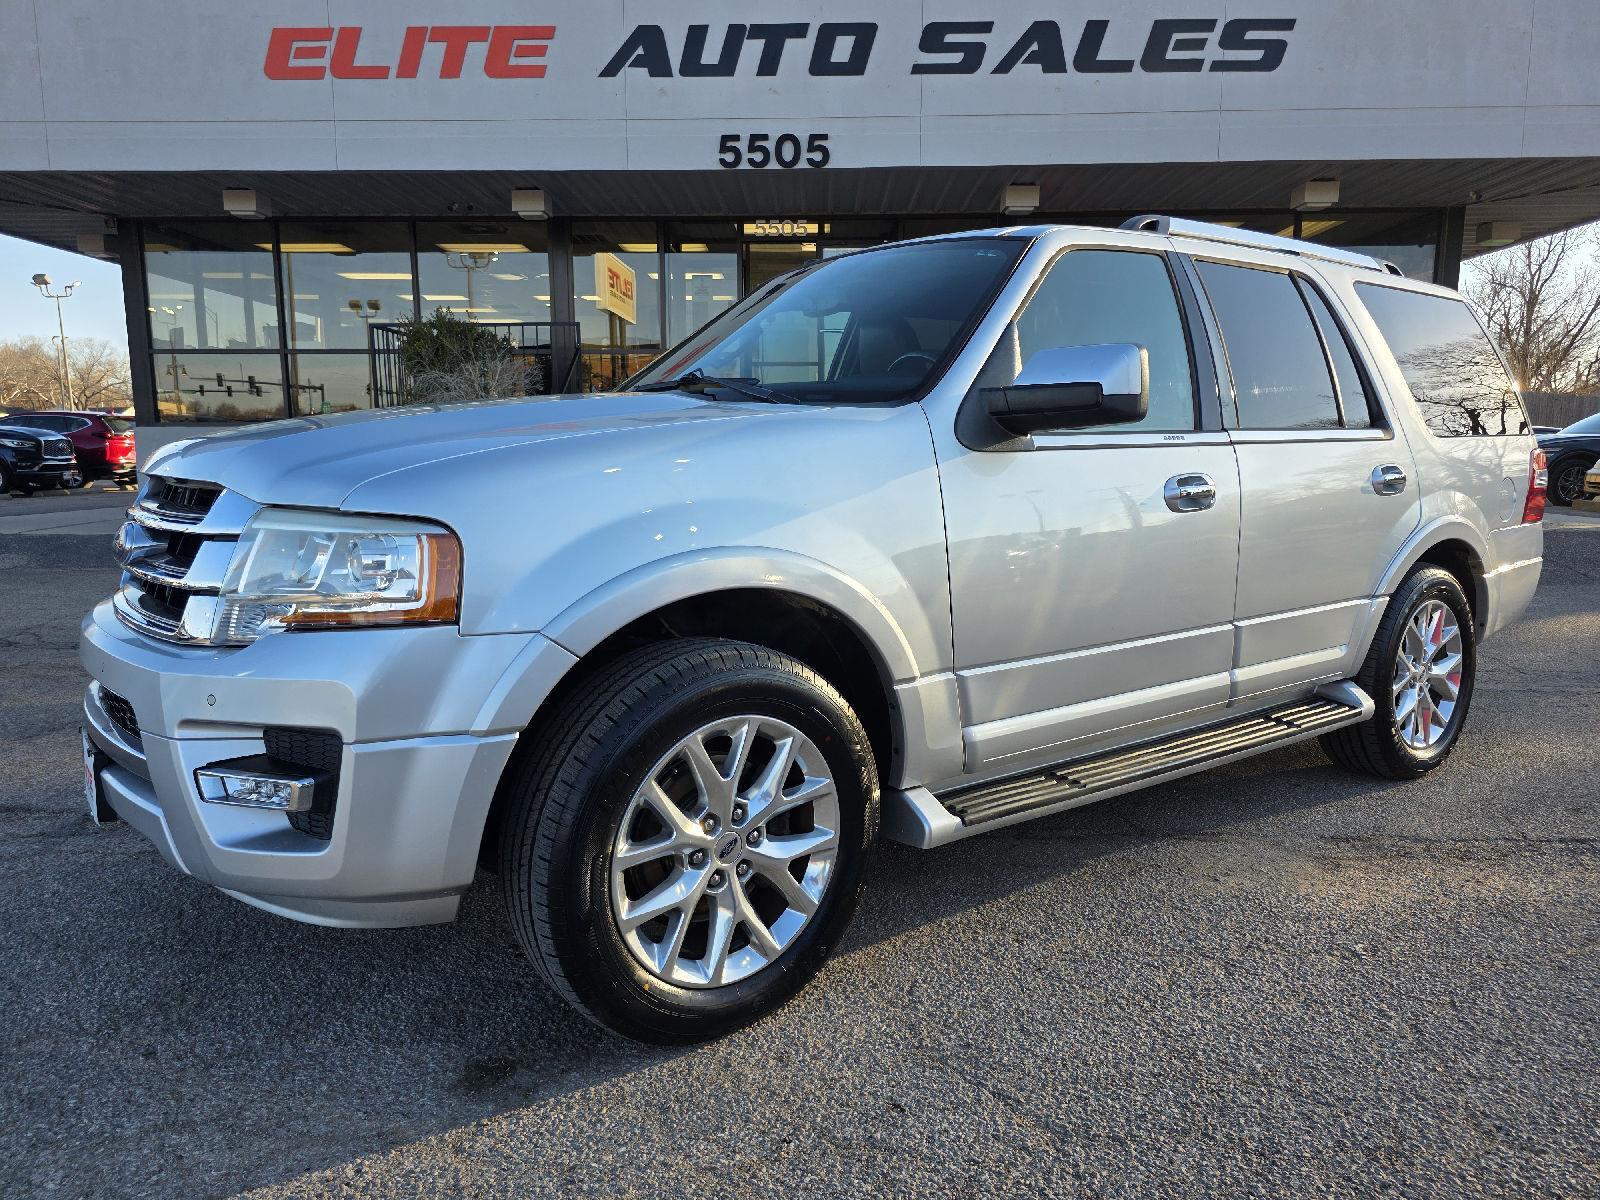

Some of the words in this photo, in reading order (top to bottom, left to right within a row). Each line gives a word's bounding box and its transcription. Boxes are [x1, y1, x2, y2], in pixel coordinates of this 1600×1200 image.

[264, 26, 554, 79] ELITE
[598, 23, 878, 78] AUTO
[911, 18, 1296, 75] SALES
[718, 133, 830, 169] 5505
[754, 219, 808, 236] 5505
